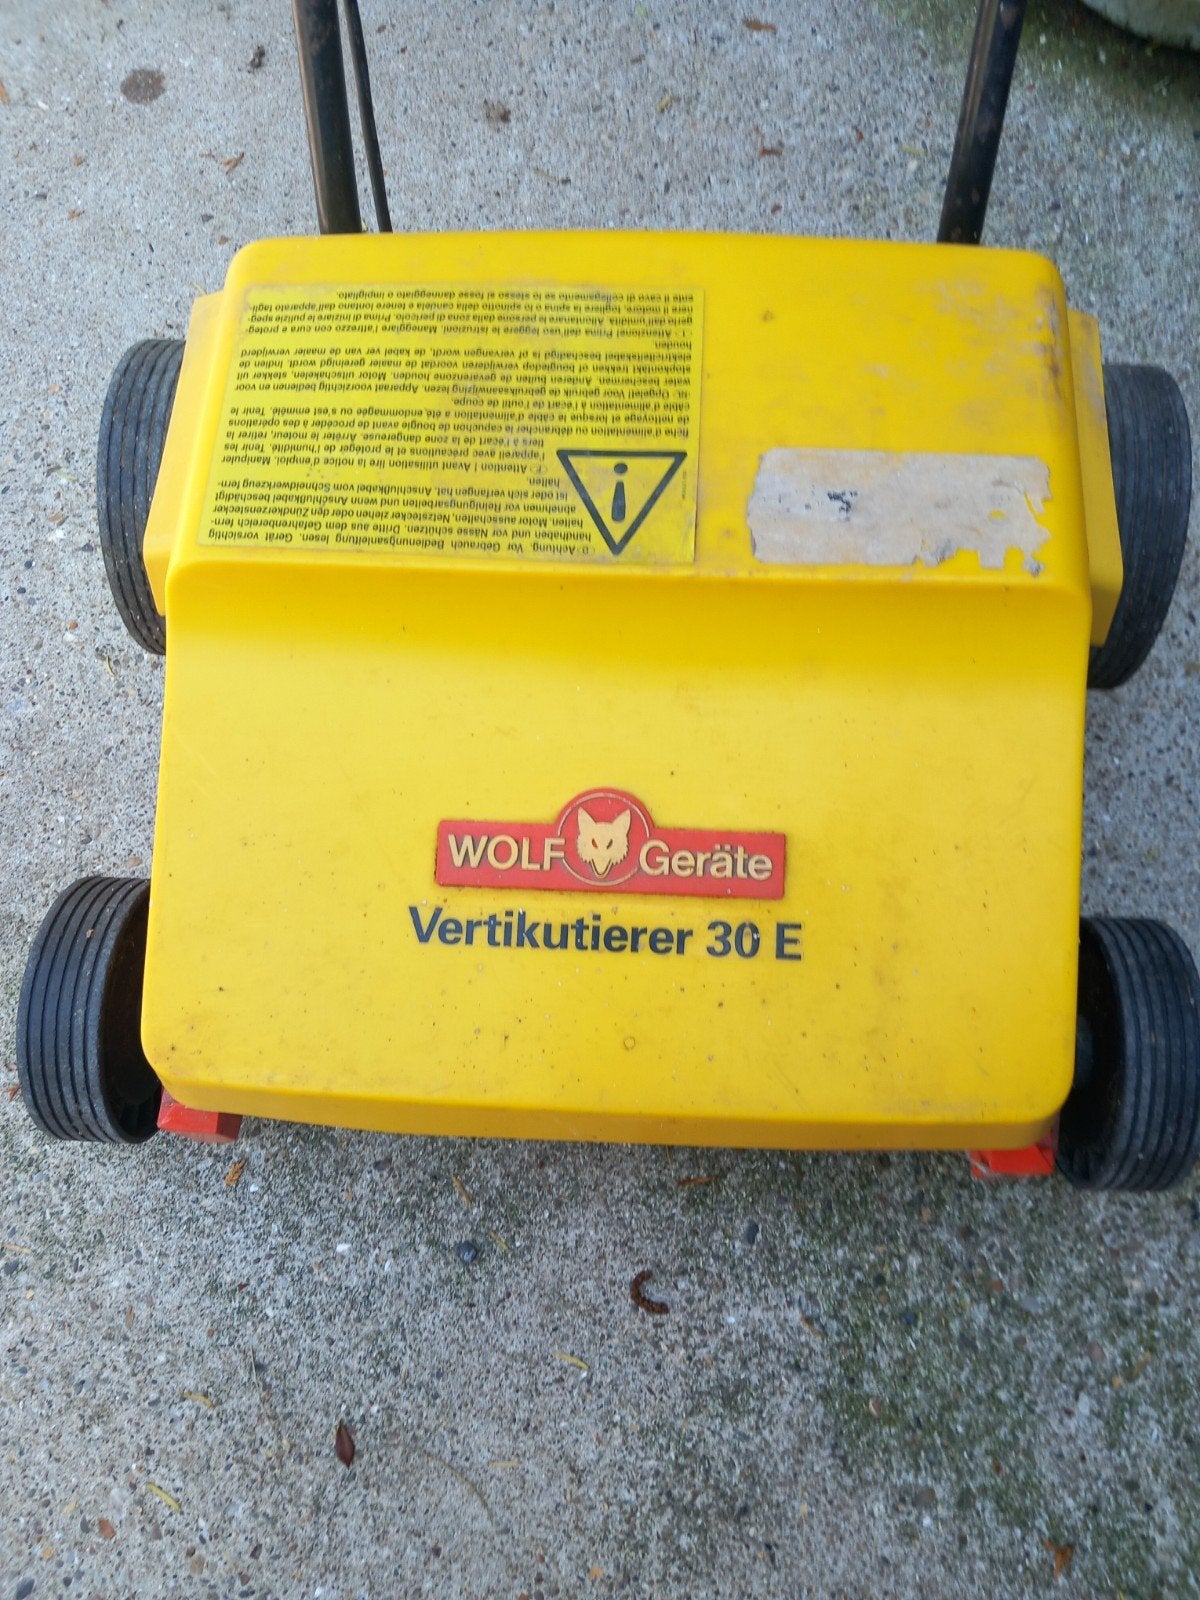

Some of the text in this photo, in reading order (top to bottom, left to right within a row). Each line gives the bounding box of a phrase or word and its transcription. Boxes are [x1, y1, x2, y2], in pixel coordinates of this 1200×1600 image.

[226, 430, 235, 440] la
[238, 431, 268, 440] retirer
[310, 432, 320, 441] le
[425, 435, 448, 443] zone
[224, 443, 238, 452] les
[242, 443, 264, 452] Tenir
[324, 444, 336, 454] de
[522, 439, 544, 449] tiers
[385, 446, 394, 456] le
[397, 447, 406, 456] et
[473, 450, 496, 458] avec
[499, 449, 545, 462] l'appareil
[222, 454, 271, 465] Manipuler
[323, 457, 354, 468] notice
[358, 459, 366, 468] la
[370, 459, 386, 469] lire
[389, 460, 439, 471] utilisation
[442, 462, 471, 472] Avant
[481, 463, 527, 474] Attention
[218, 480, 240, 490] fern-
[242, 479, 331, 492] Schneidwerkzeug
[333, 483, 354, 491] vom
[357, 484, 432, 496] Anschlußkabel
[455, 486, 505, 499] verfangen
[508, 490, 529, 500] sich
[532, 491, 554, 501] oder
[556, 492, 568, 502] ist
[215, 491, 576, 516] abnehmen vor Reinigungsarbeiten und wenn Anschlußkabel beschädigt
[213, 506, 309, 518] Zündkerzenstecker
[311, 508, 330, 518] den
[331, 509, 354, 519] oder
[356, 510, 389, 521] ziehen
[212, 518, 234, 528] fern-
[391, 512, 450, 524] Netzstecker
[518, 517, 548, 528] Motor
[238, 518, 322, 530] Gefahrenbereich
[326, 521, 348, 532] dem
[351, 522, 370, 530] aus
[373, 523, 400, 534] Dritte
[208, 528, 259, 542] vorsichtig
[265, 532, 293, 543] Gerät
[457, 528, 488, 539] Nässe
[512, 530, 531, 540] und
[535, 531, 591, 542] handhaben
[335, 533, 444, 549] Bedienungsanleitung
[451, 540, 500, 552] Gebrauch
[508, 542, 523, 553] Vor
[447, 832, 772, 880] WOLF Geräte
[408, 904, 801, 961] Vertikutierer 30 E
